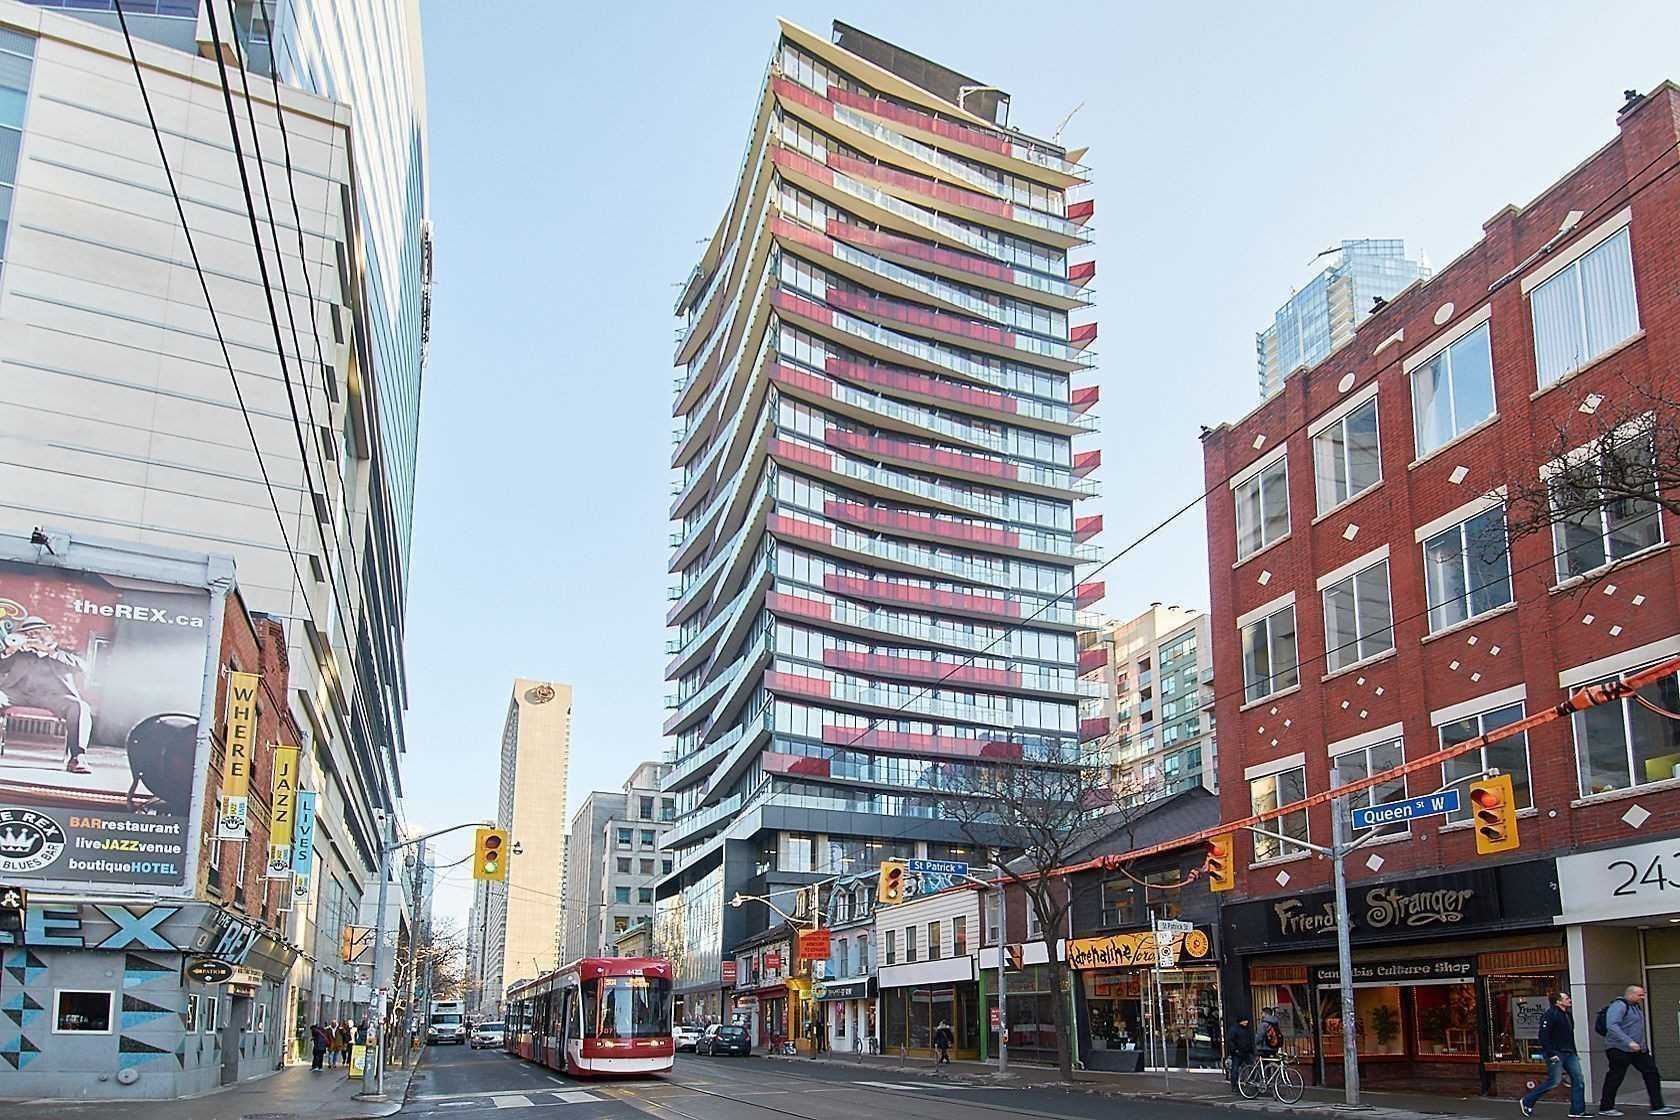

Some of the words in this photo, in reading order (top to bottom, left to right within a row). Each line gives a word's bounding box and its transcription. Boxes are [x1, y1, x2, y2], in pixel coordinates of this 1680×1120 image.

[73, 599, 203, 628] theREX.ca
[231, 687, 254, 777] WHERE
[276, 763, 290, 822] JAZZ
[1364, 806, 1413, 824] Queen
[1416, 801, 1425, 809] St
[1431, 796, 1445, 811] W
[22, 812, 60, 837] REX
[69, 816, 180, 834] BARrestaurant
[298, 800, 311, 861] LIVES
[75, 837, 182, 854] liveJAZZvenue
[3, 859, 42, 870] BLUES
[68, 858, 178, 875] boutiqueHOTEL
[914, 861, 923, 870] St
[926, 862, 956, 872] Patrick
[1366, 887, 1474, 928] Stranger
[0, 903, 183, 950] EX
[213, 918, 262, 965] REX
[1069, 939, 1132, 969] Adrenaline
[1377, 964, 1431, 976] Culture
[1434, 961, 1471, 974] Shop
